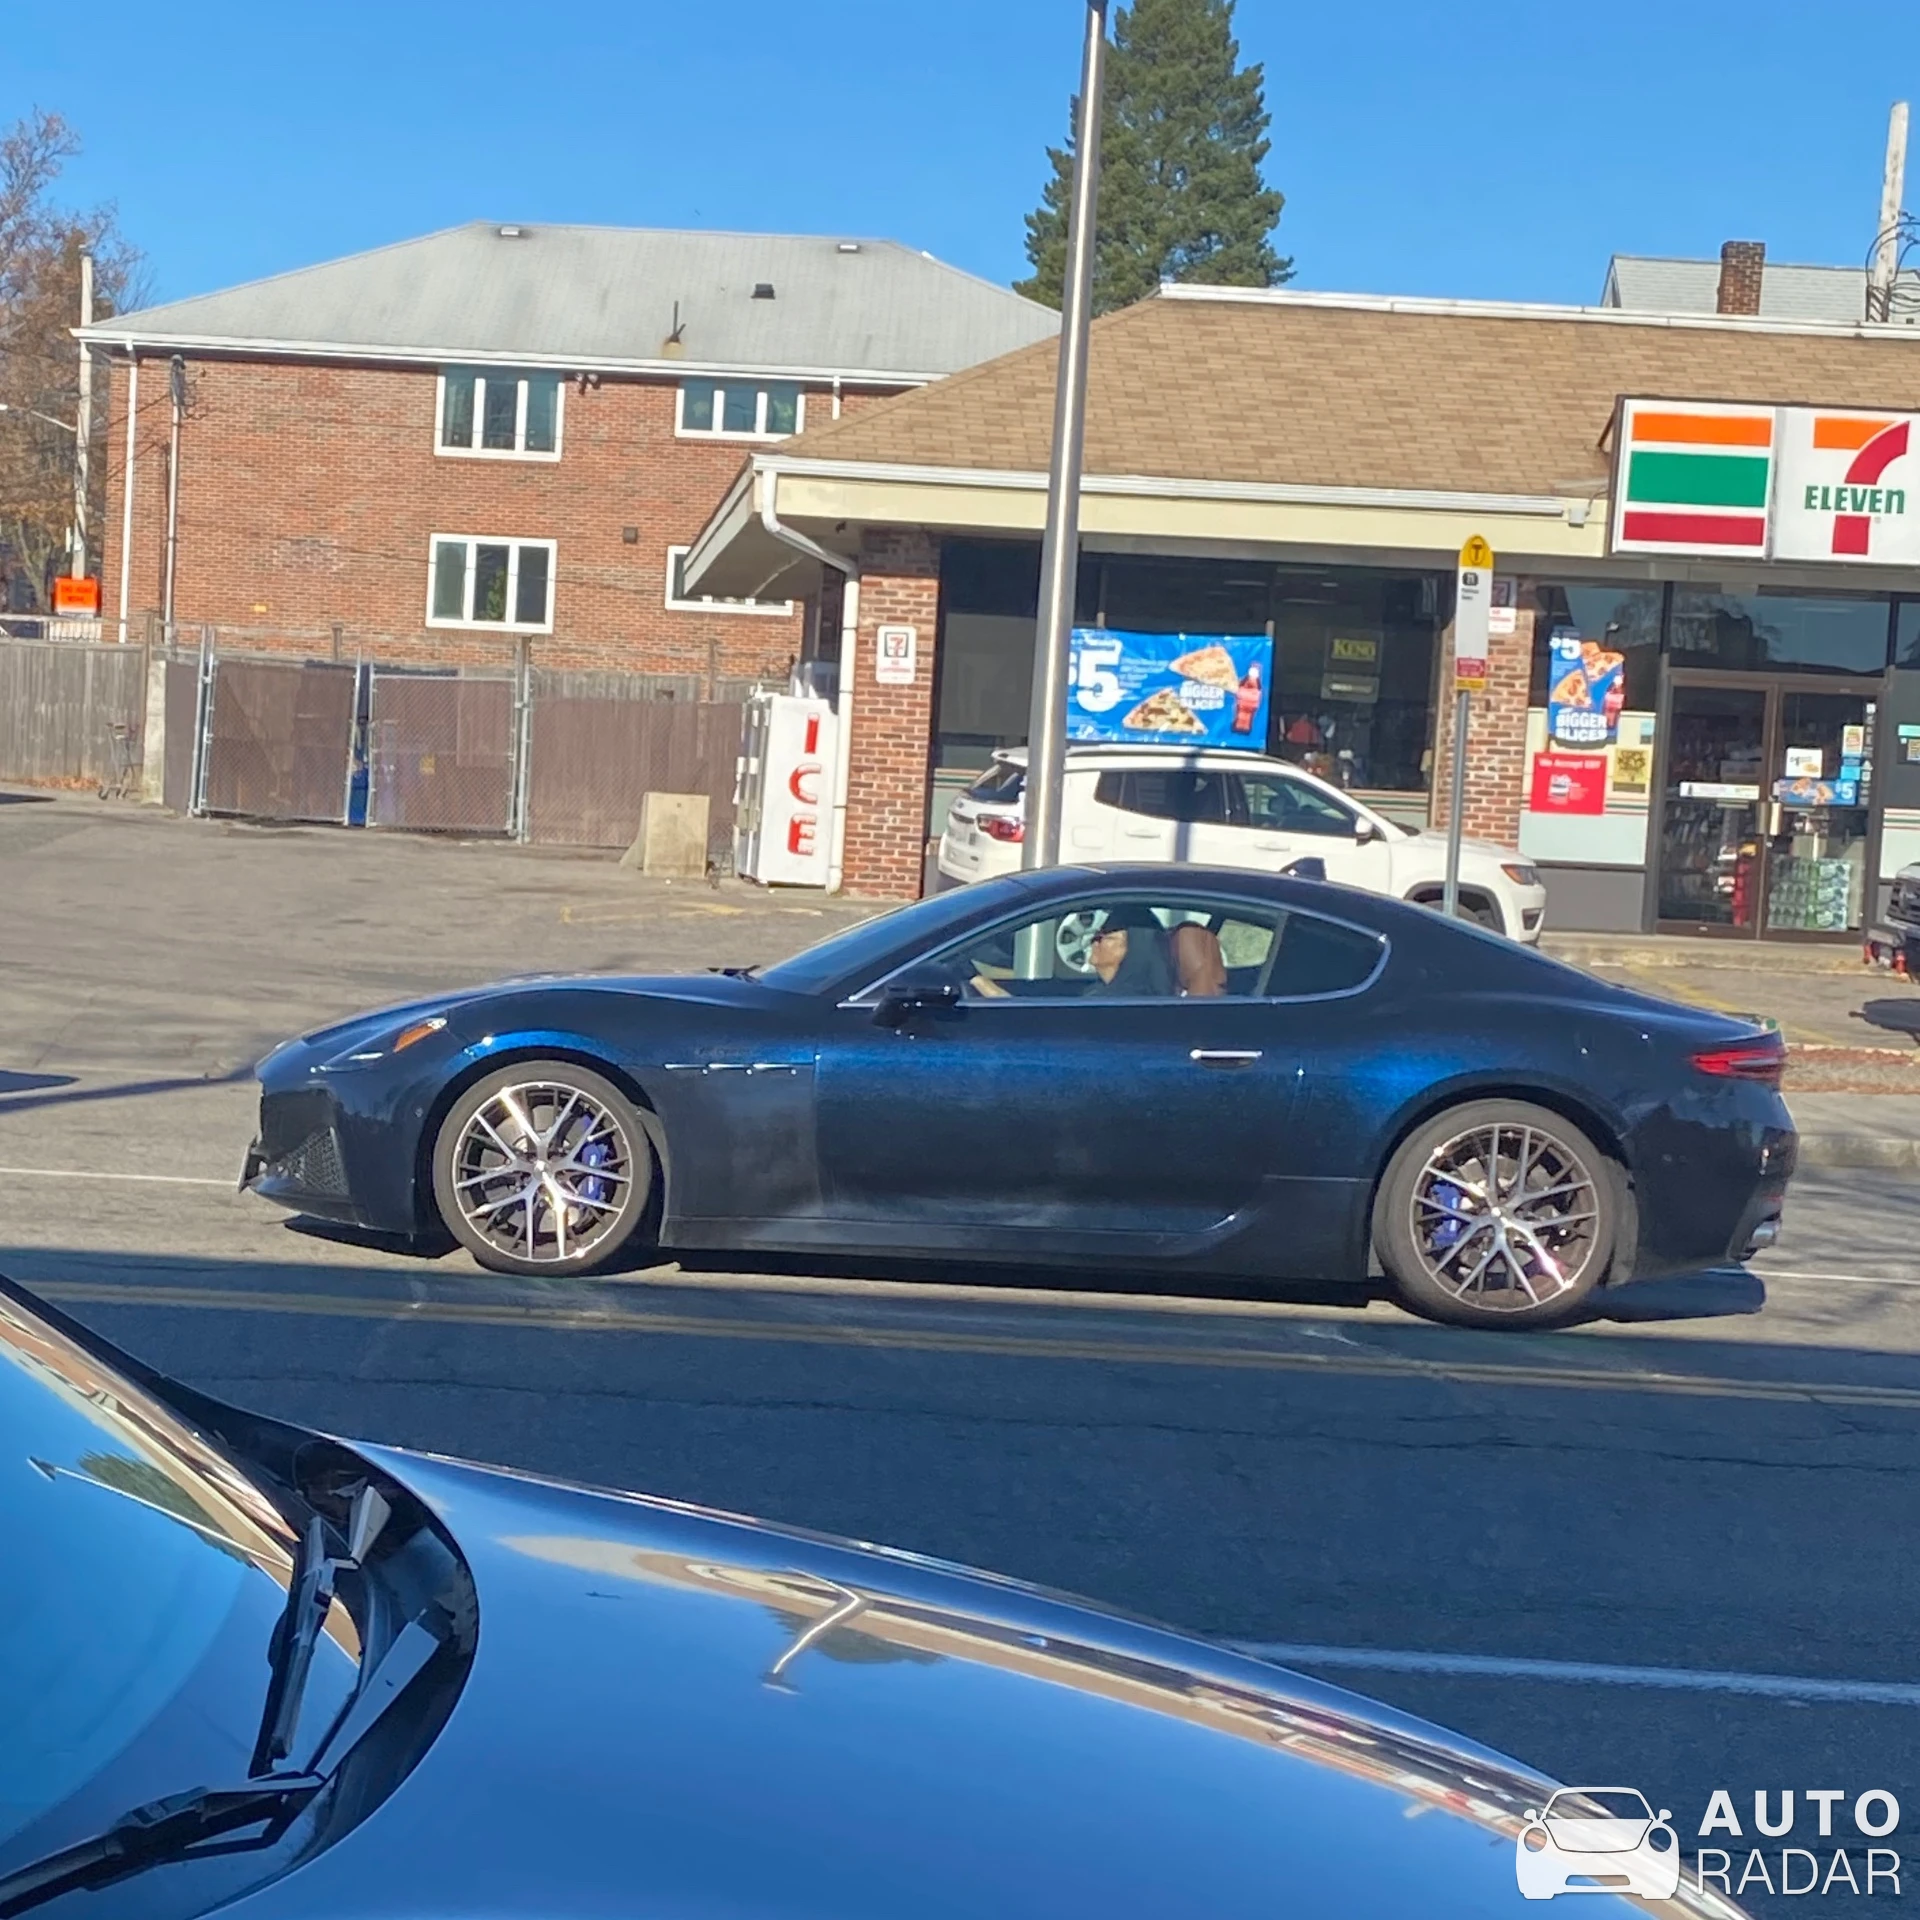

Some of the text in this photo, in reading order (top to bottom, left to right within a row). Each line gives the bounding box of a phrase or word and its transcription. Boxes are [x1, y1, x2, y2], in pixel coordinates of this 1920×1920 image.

[1812, 418, 1910, 555] 7
[787, 712, 822, 857] ICE
[1556, 712, 1608, 729] BIGGER
